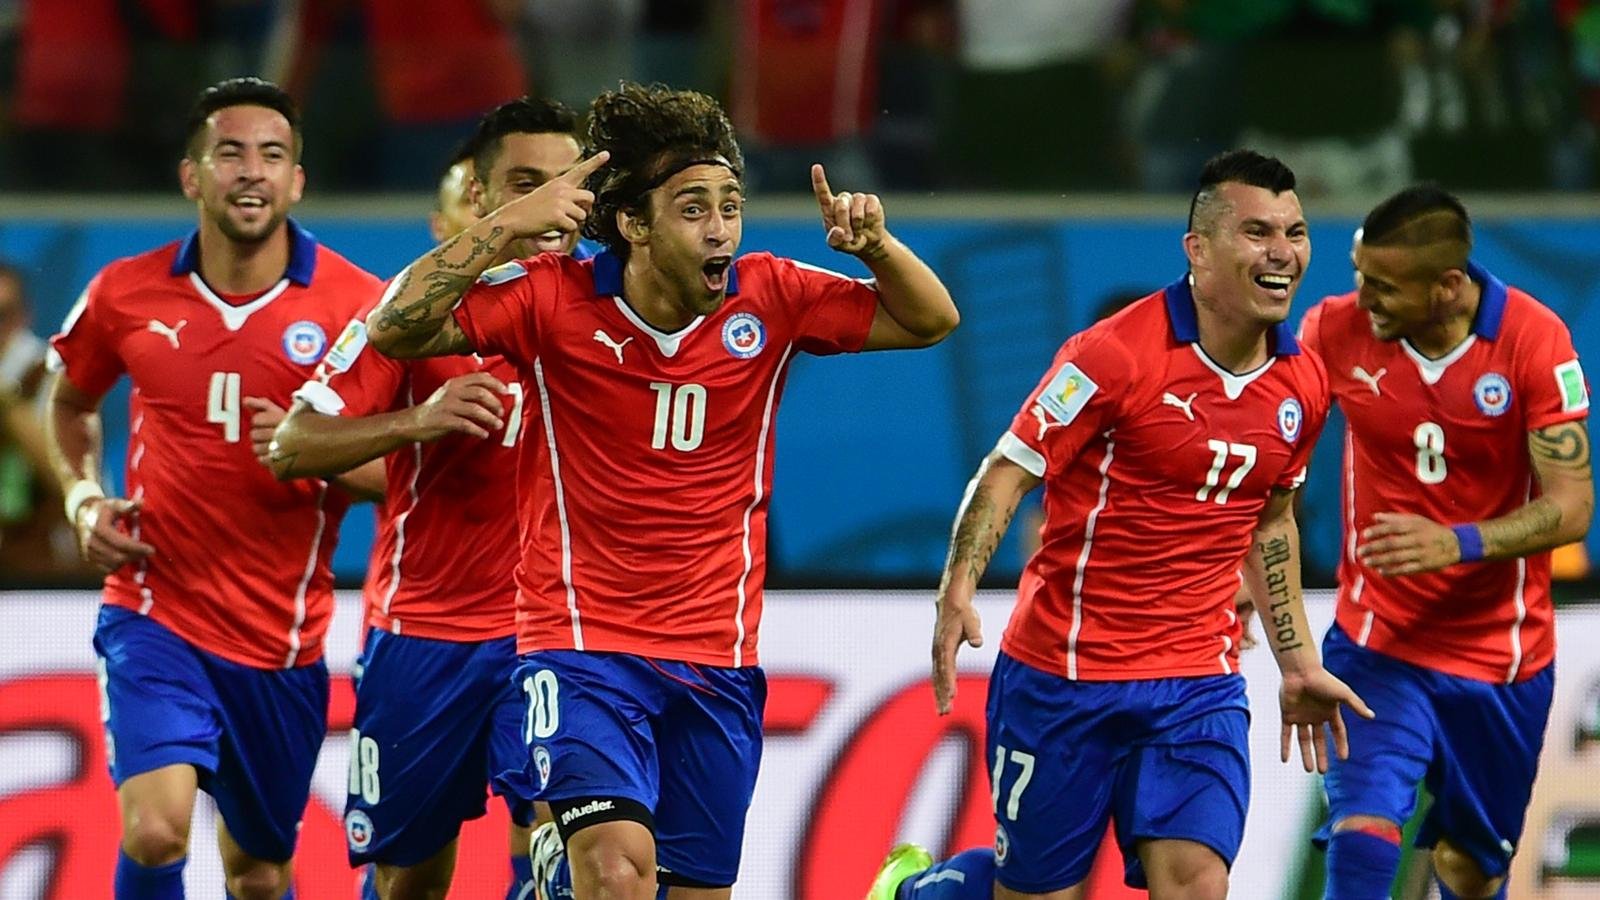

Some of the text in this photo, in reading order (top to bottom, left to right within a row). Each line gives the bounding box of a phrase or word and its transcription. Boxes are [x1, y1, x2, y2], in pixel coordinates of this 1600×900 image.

[207, 371, 241, 442] 4
[649, 382, 707, 452] 10
[1195, 438, 1257, 505] 17
[1413, 421, 1447, 485] 8
[1259, 534, 1303, 652] Marisol
[523, 669, 559, 745] 10
[349, 728, 380, 805] 18
[993, 744, 1035, 821] 17
